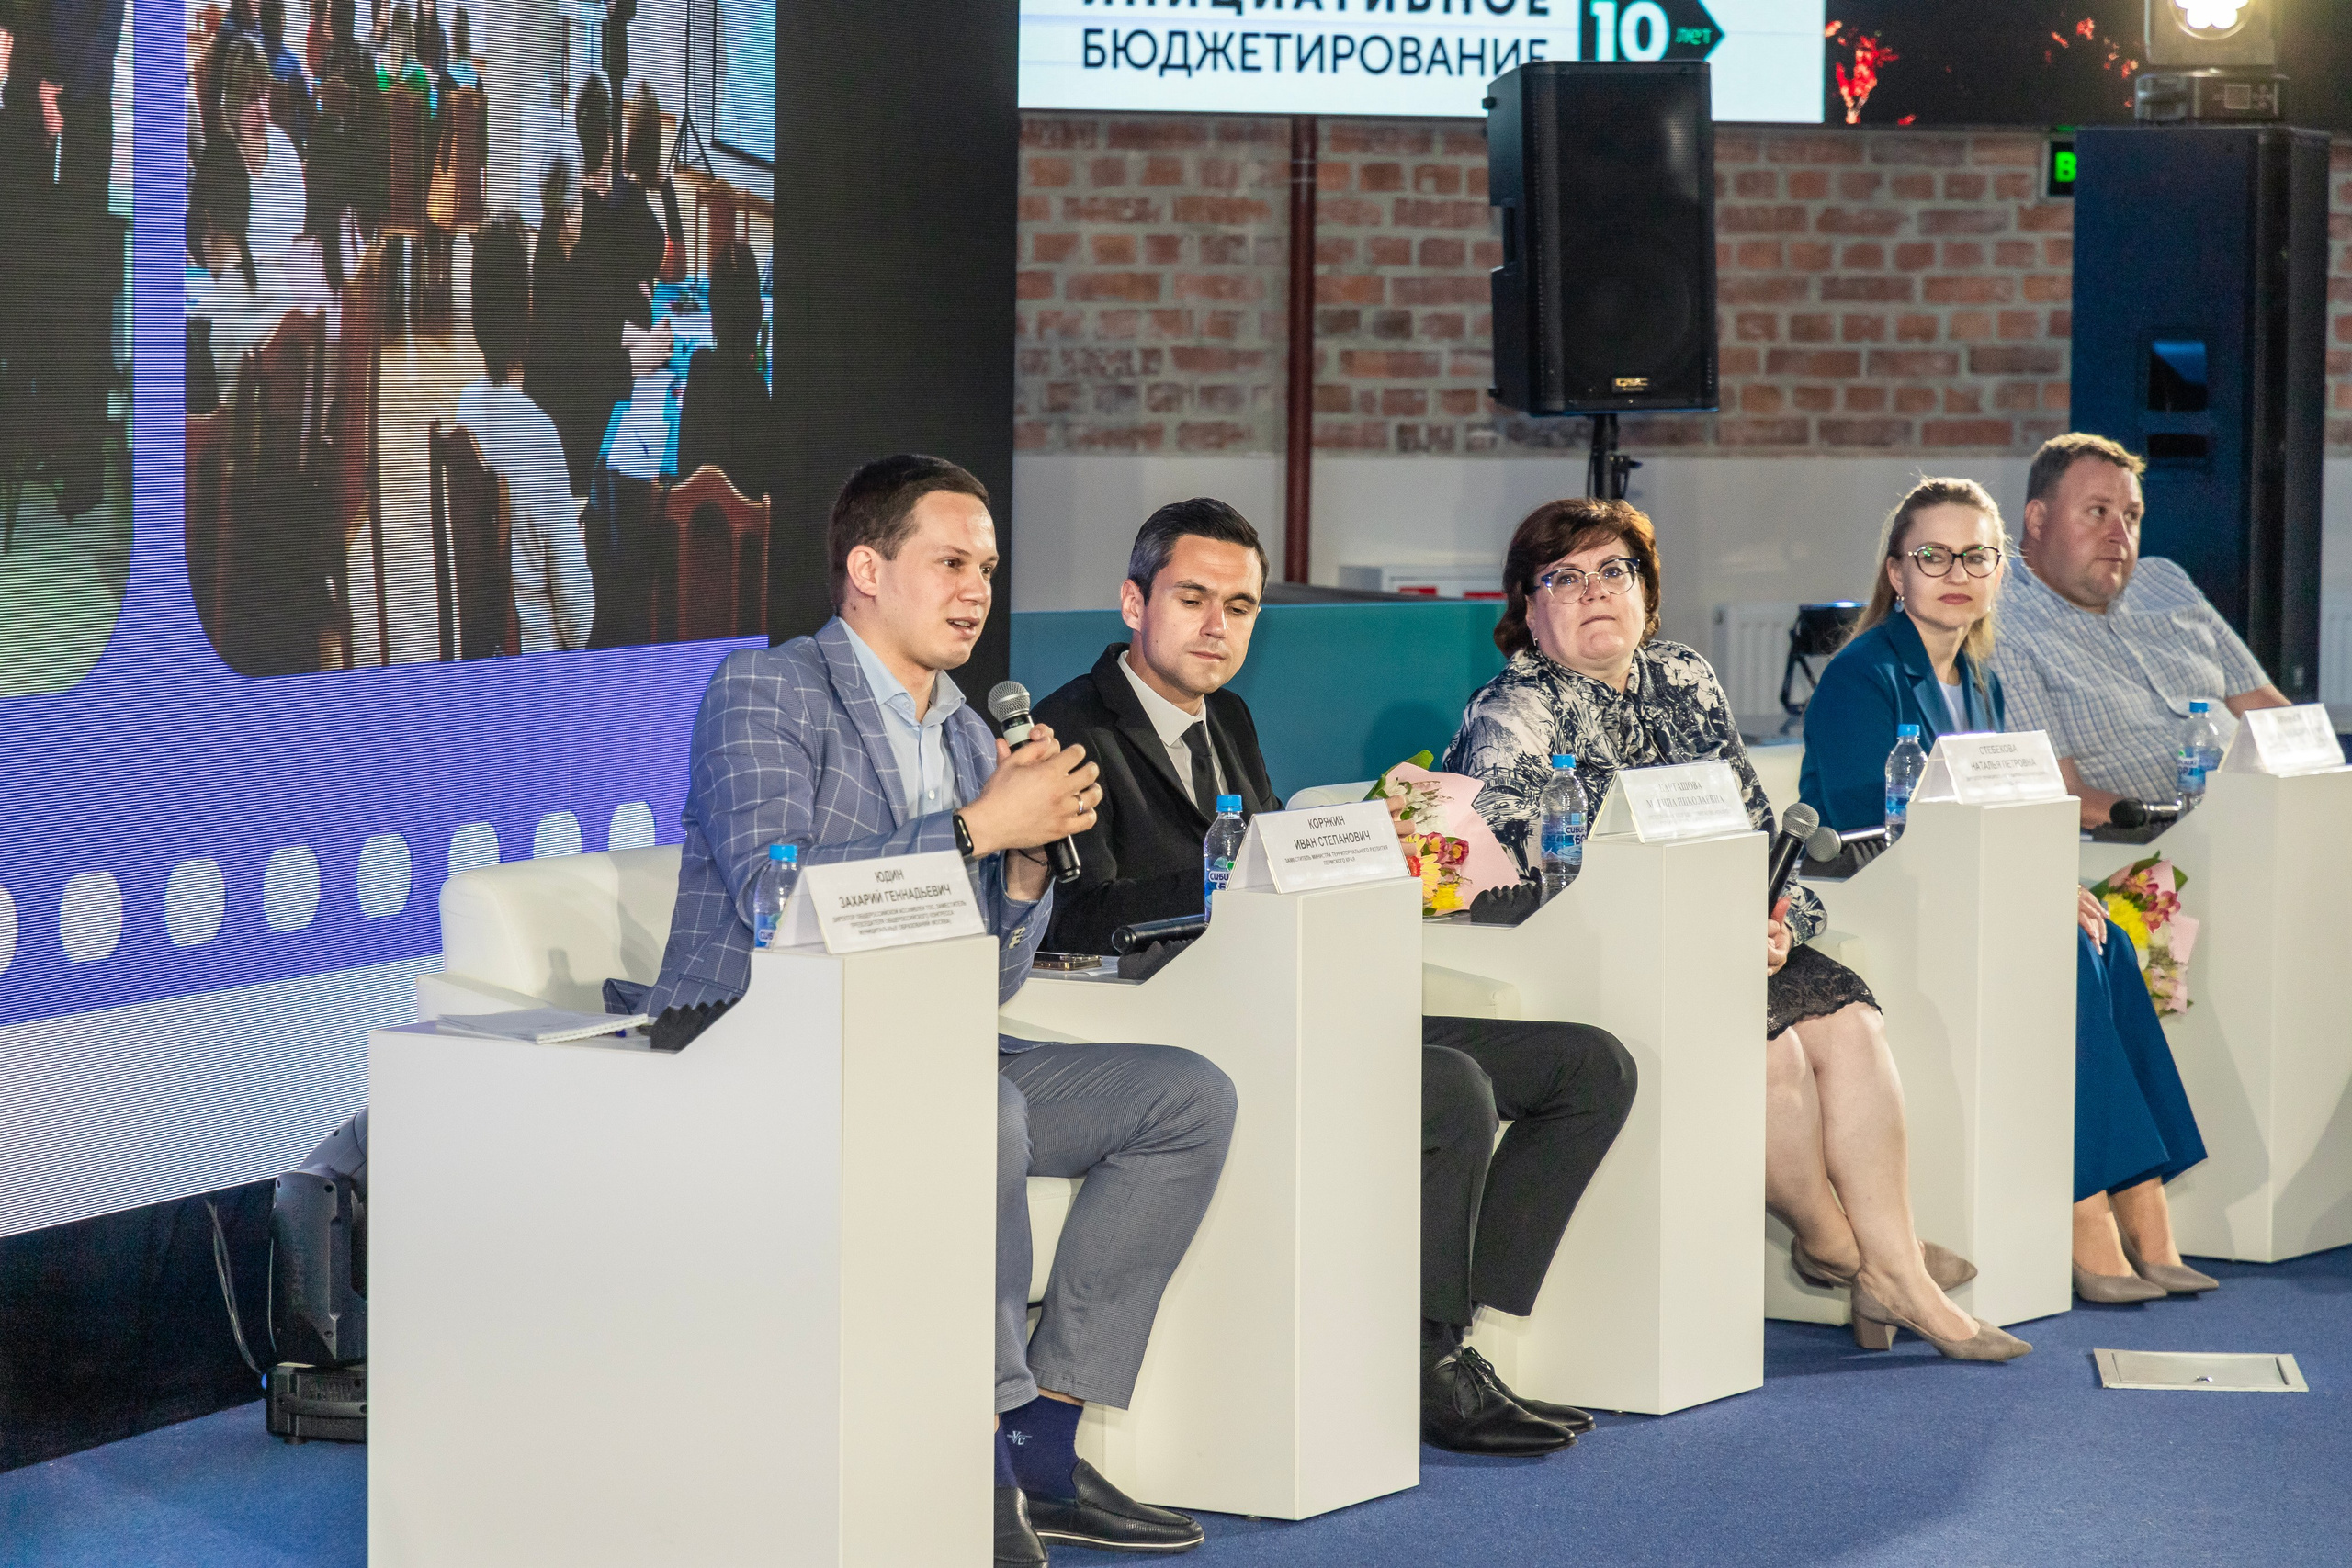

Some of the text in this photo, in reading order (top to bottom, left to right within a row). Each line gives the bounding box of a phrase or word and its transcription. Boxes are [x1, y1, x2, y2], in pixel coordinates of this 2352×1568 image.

[1590, 0, 1669, 61] 10
[1083, 28, 1548, 77] БЮДЖЕТИРОВАНИЕ
[1971, 758, 2037, 772] НАТАЛЬЯ ПЕТРОВНА
[1677, 795, 1725, 807] НИКОЛАЕВНА
[1307, 816, 1345, 829] КОРЯКИН
[1294, 830, 1372, 851] ИВАН СТЕПАНОВИЧ
[875, 868, 904, 884] ЮДИН
[839, 884, 952, 909] ЗАХАРИЙ ГЕННАДЬЕВИЧ
